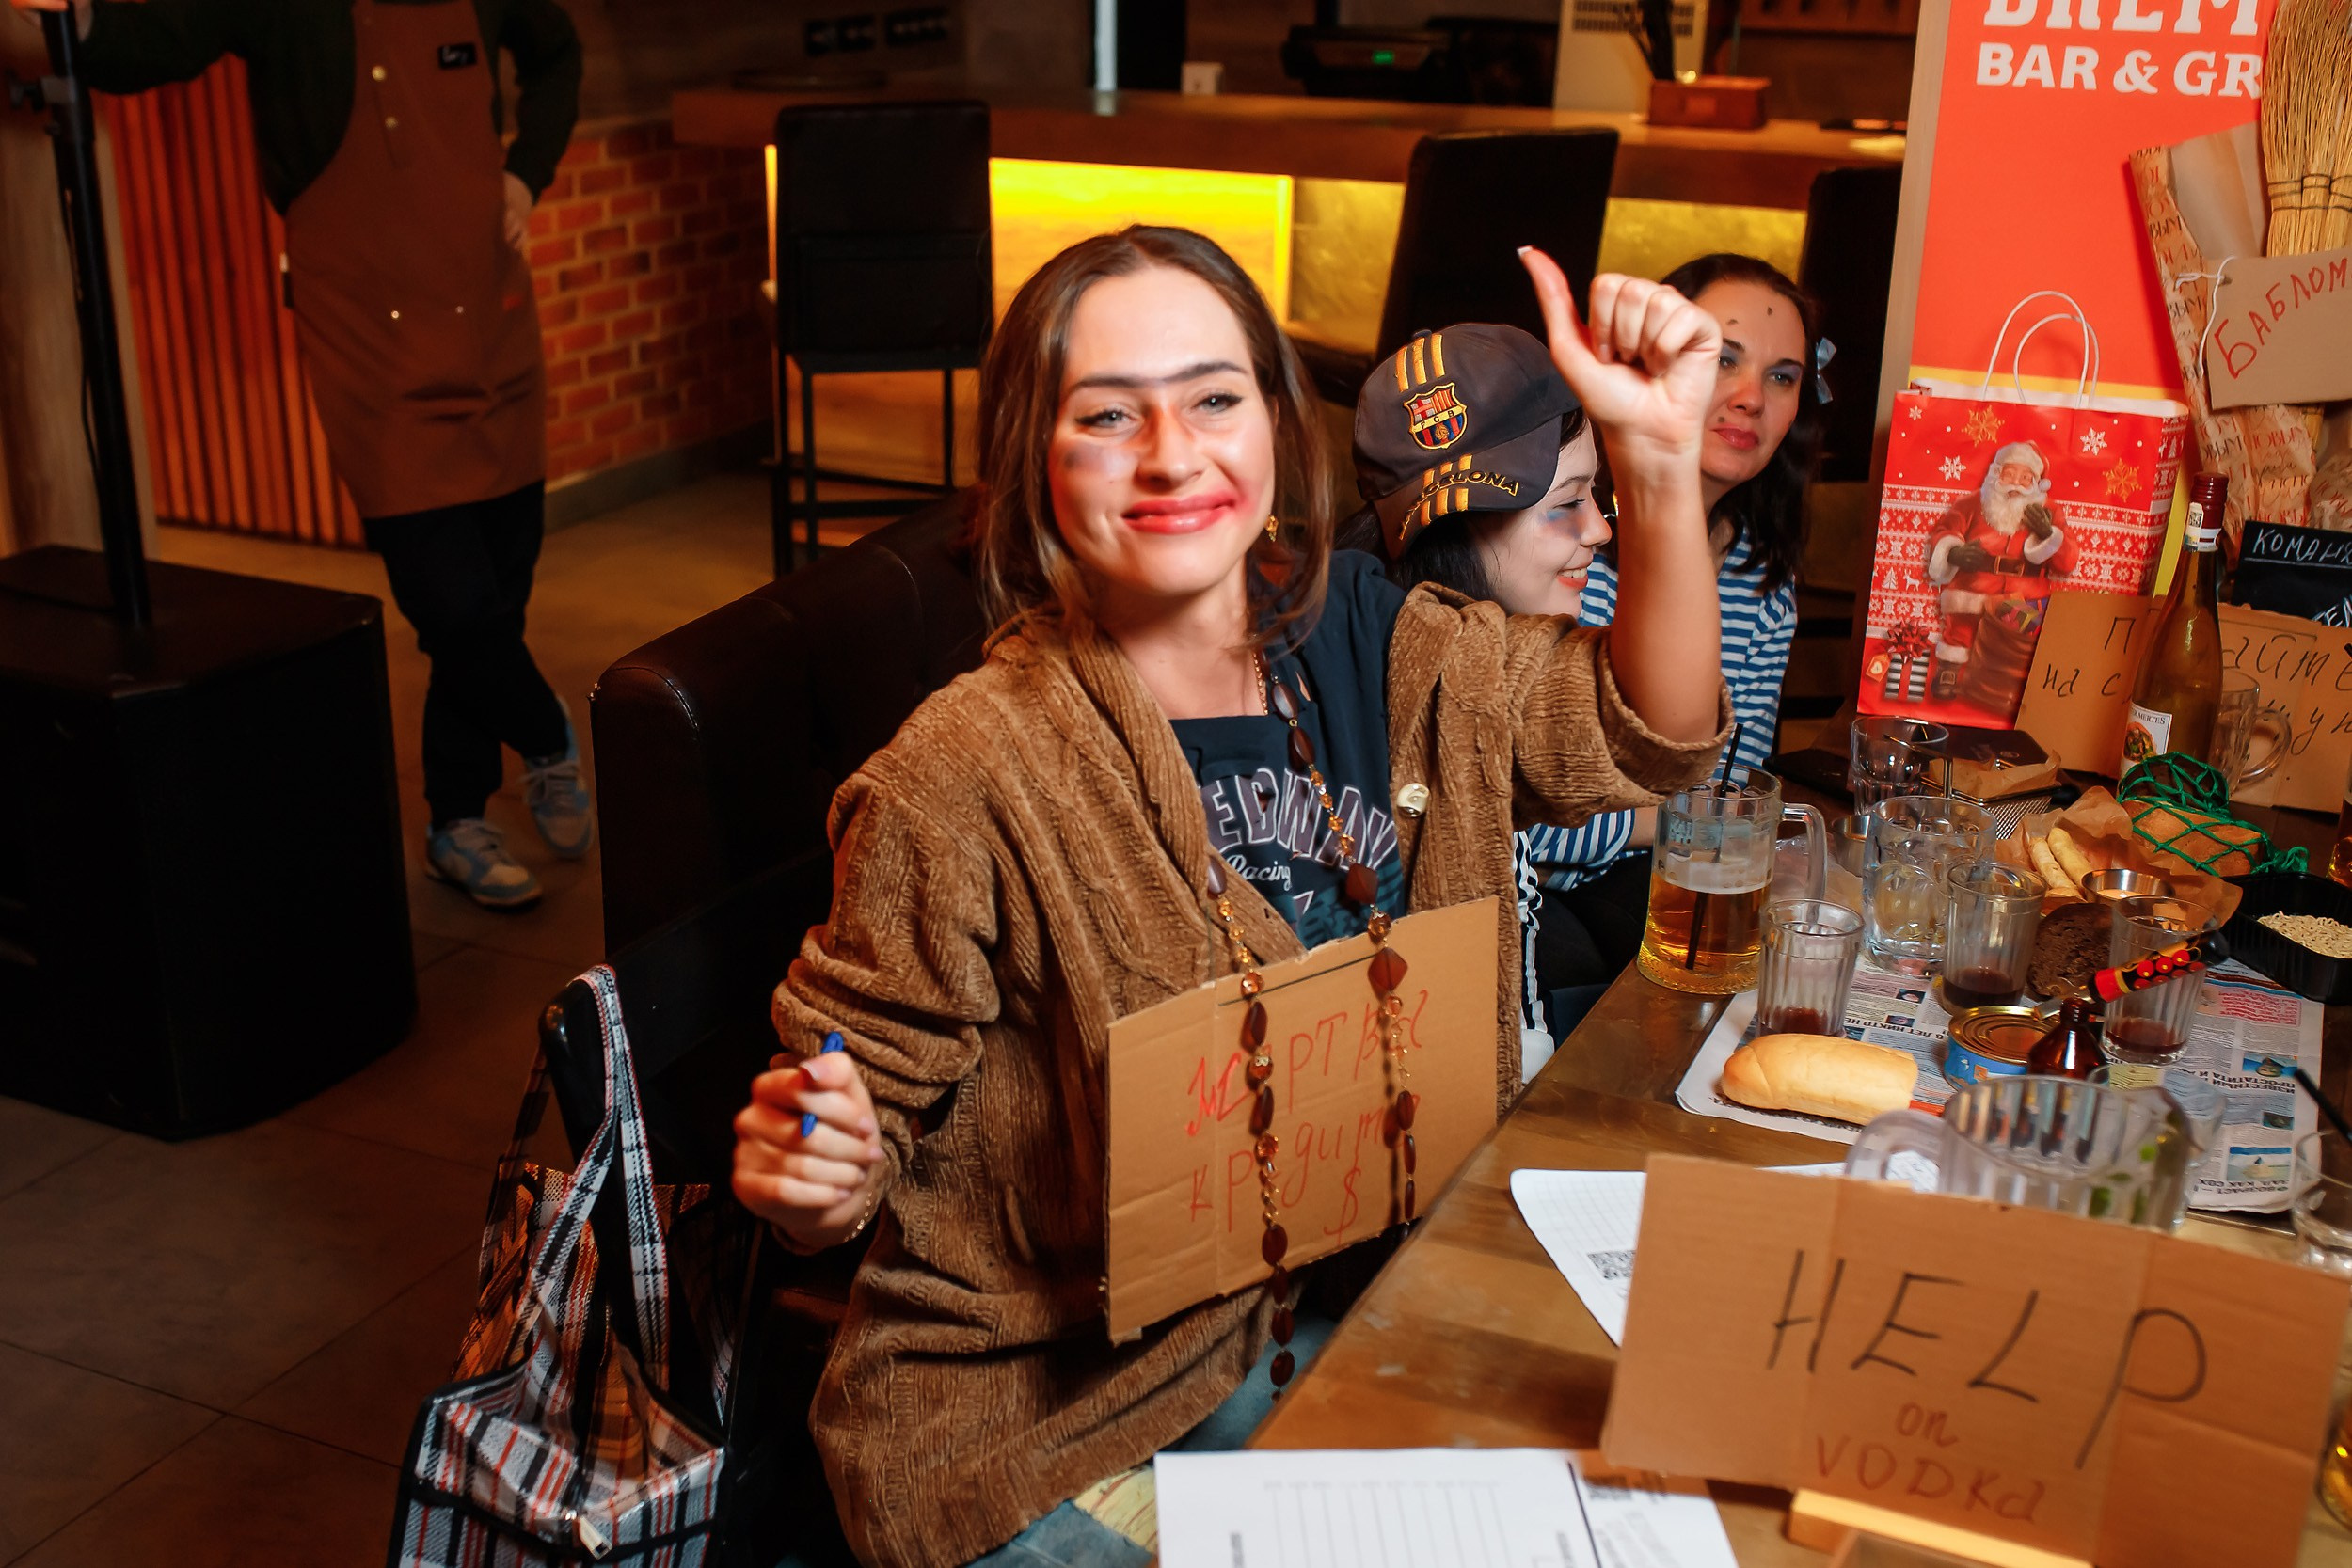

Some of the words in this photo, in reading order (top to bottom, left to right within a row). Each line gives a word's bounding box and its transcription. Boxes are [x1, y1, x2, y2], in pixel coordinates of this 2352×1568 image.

[1976, 41, 2100, 90] BAR
[2113, 49, 2159, 95] &
[1224, 853, 1292, 892] Racing
[1863, 1021, 1905, 1033] НИКТО
[1765, 1249, 2208, 1470] HELP
[1895, 1400, 1961, 1449] on
